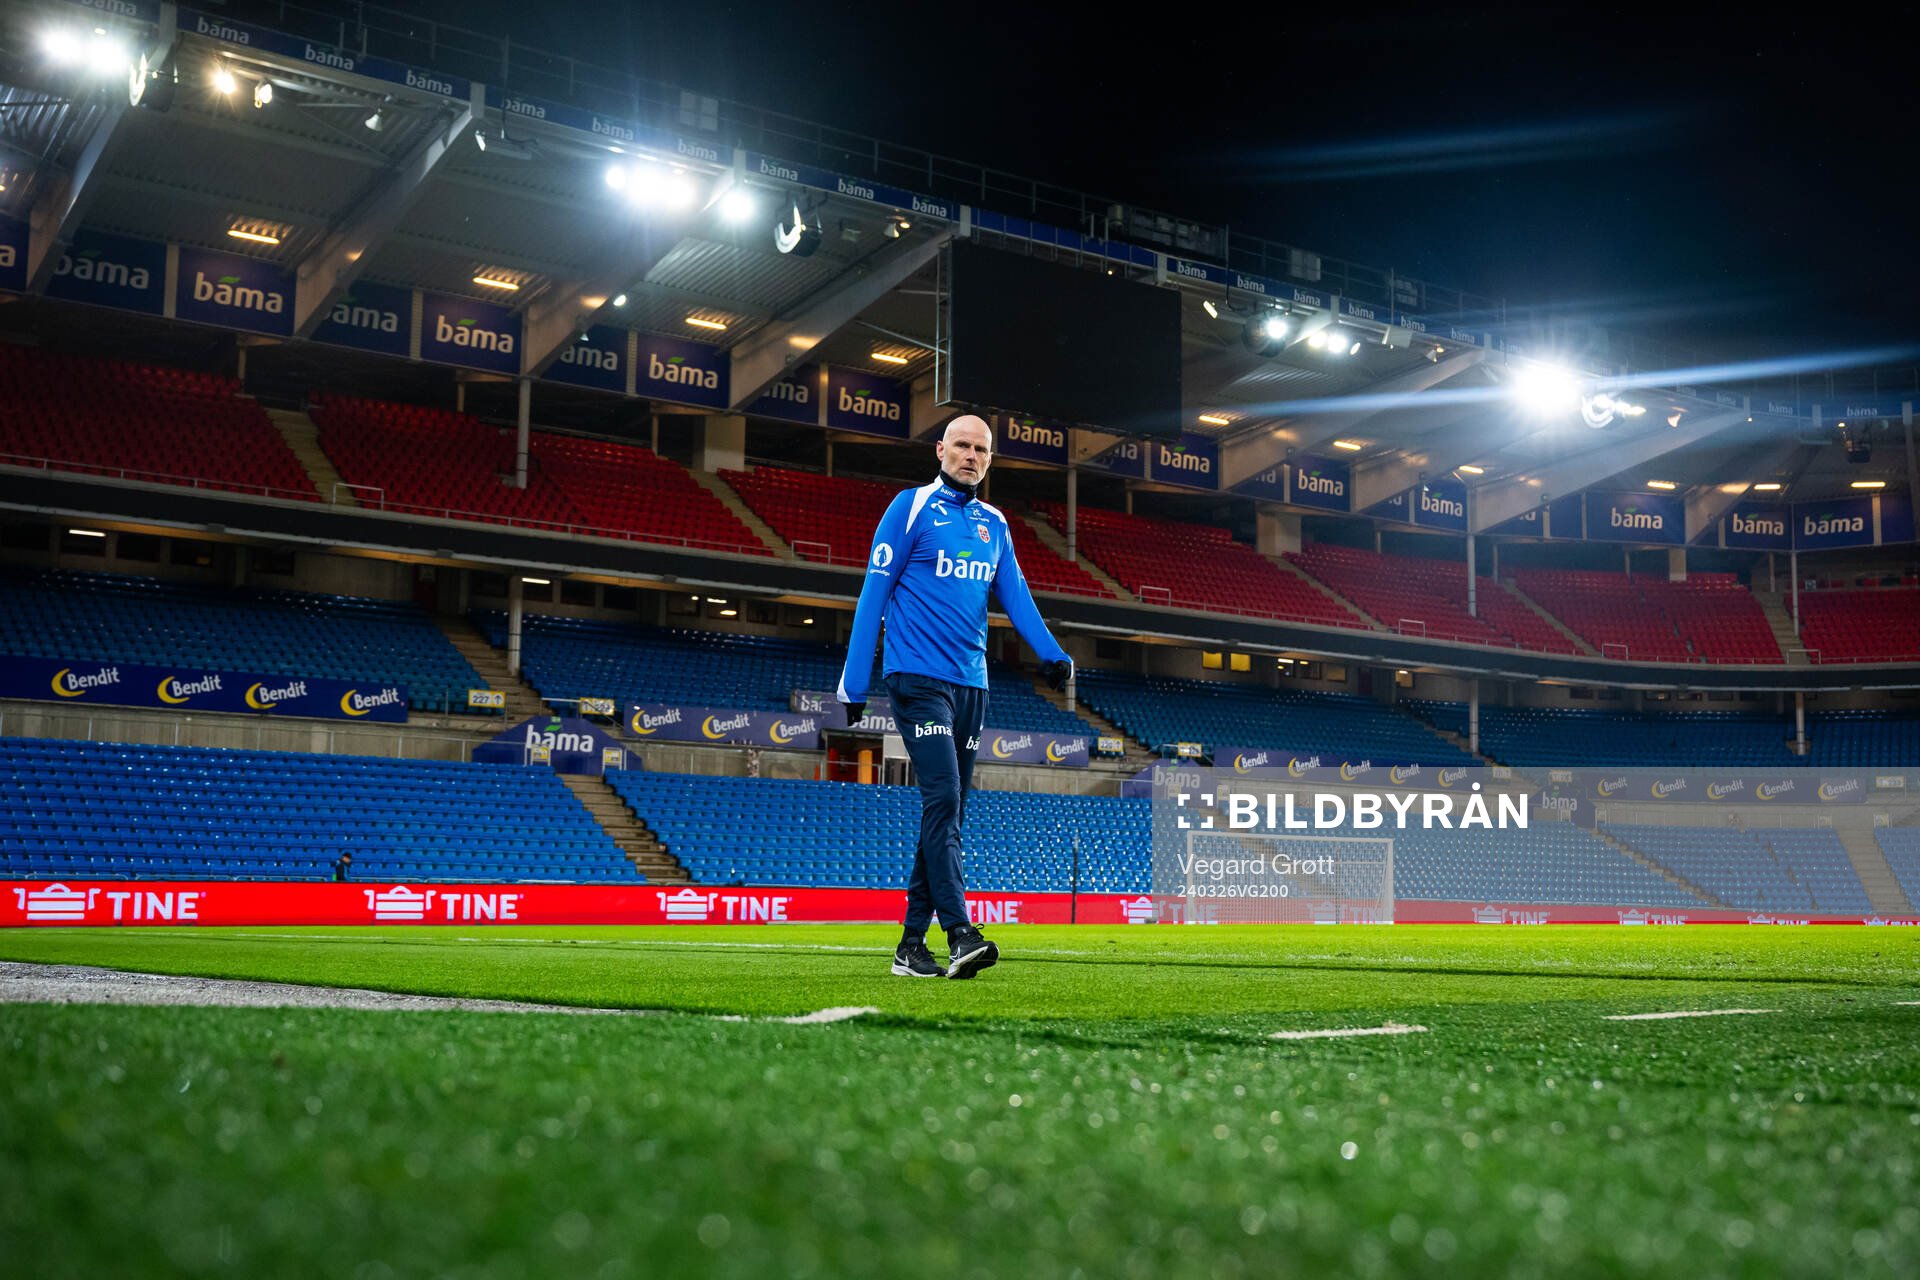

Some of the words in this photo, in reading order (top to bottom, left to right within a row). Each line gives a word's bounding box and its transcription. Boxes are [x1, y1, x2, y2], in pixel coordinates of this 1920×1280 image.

[197, 16, 249, 45] bama
[305, 44, 354, 72] bama
[407, 69, 452, 96] bama
[592, 117, 634, 141] bama
[678, 139, 717, 162] bama
[760, 159, 798, 182] bama
[837, 178, 874, 200] bama
[912, 196, 947, 217] bama
[1177, 261, 1207, 280] bama
[194, 272, 283, 313] bama
[1237, 274, 1265, 294] bama
[1294, 288, 1321, 307] bama
[331, 303, 398, 333] ama
[1349, 302, 1375, 320] bama
[436, 315, 514, 353] bama
[1401, 315, 1426, 333] bama
[1451, 327, 1475, 345] bama
[560, 345, 618, 370] ama
[648, 354, 718, 389] bama
[839, 387, 900, 421] bama
[1008, 417, 1064, 447] bama
[1160, 446, 1210, 473] bama
[1298, 470, 1344, 496] bama
[1421, 492, 1463, 517] bama
[1611, 508, 1663, 530] bama
[1733, 514, 1784, 536] bama
[1804, 516, 1863, 537] bama
[67, 667, 120, 691] Bendit
[172, 675, 222, 697] Bendit
[260, 681, 307, 703] Bendit
[354, 687, 400, 710] Bendit
[643, 707, 681, 728] Bendit
[712, 713, 750, 733] Bendit
[780, 718, 816, 739] Bendit
[850, 712, 897, 730] ama
[526, 724, 593, 752] bama
[916, 723, 952, 738] bama
[1000, 734, 1033, 754] Bendit
[1053, 738, 1085, 759] Bendit
[1240, 752, 1268, 769] Bendit
[1294, 756, 1320, 776] Bendit
[1345, 760, 1371, 778] Bendit
[1154, 765, 1200, 788] bama
[1394, 764, 1420, 782] Bendit
[1444, 767, 1468, 786] Bendit
[1603, 776, 1628, 793] Bendit
[1659, 778, 1687, 797] Bendit
[1716, 780, 1744, 799] Bendit
[1763, 779, 1795, 799] Bendit
[1827, 779, 1859, 796] Bendit
[1542, 791, 1577, 811] bama
[106, 892, 198, 920] TINE
[441, 894, 518, 920] TINE
[721, 897, 788, 921] TINE
